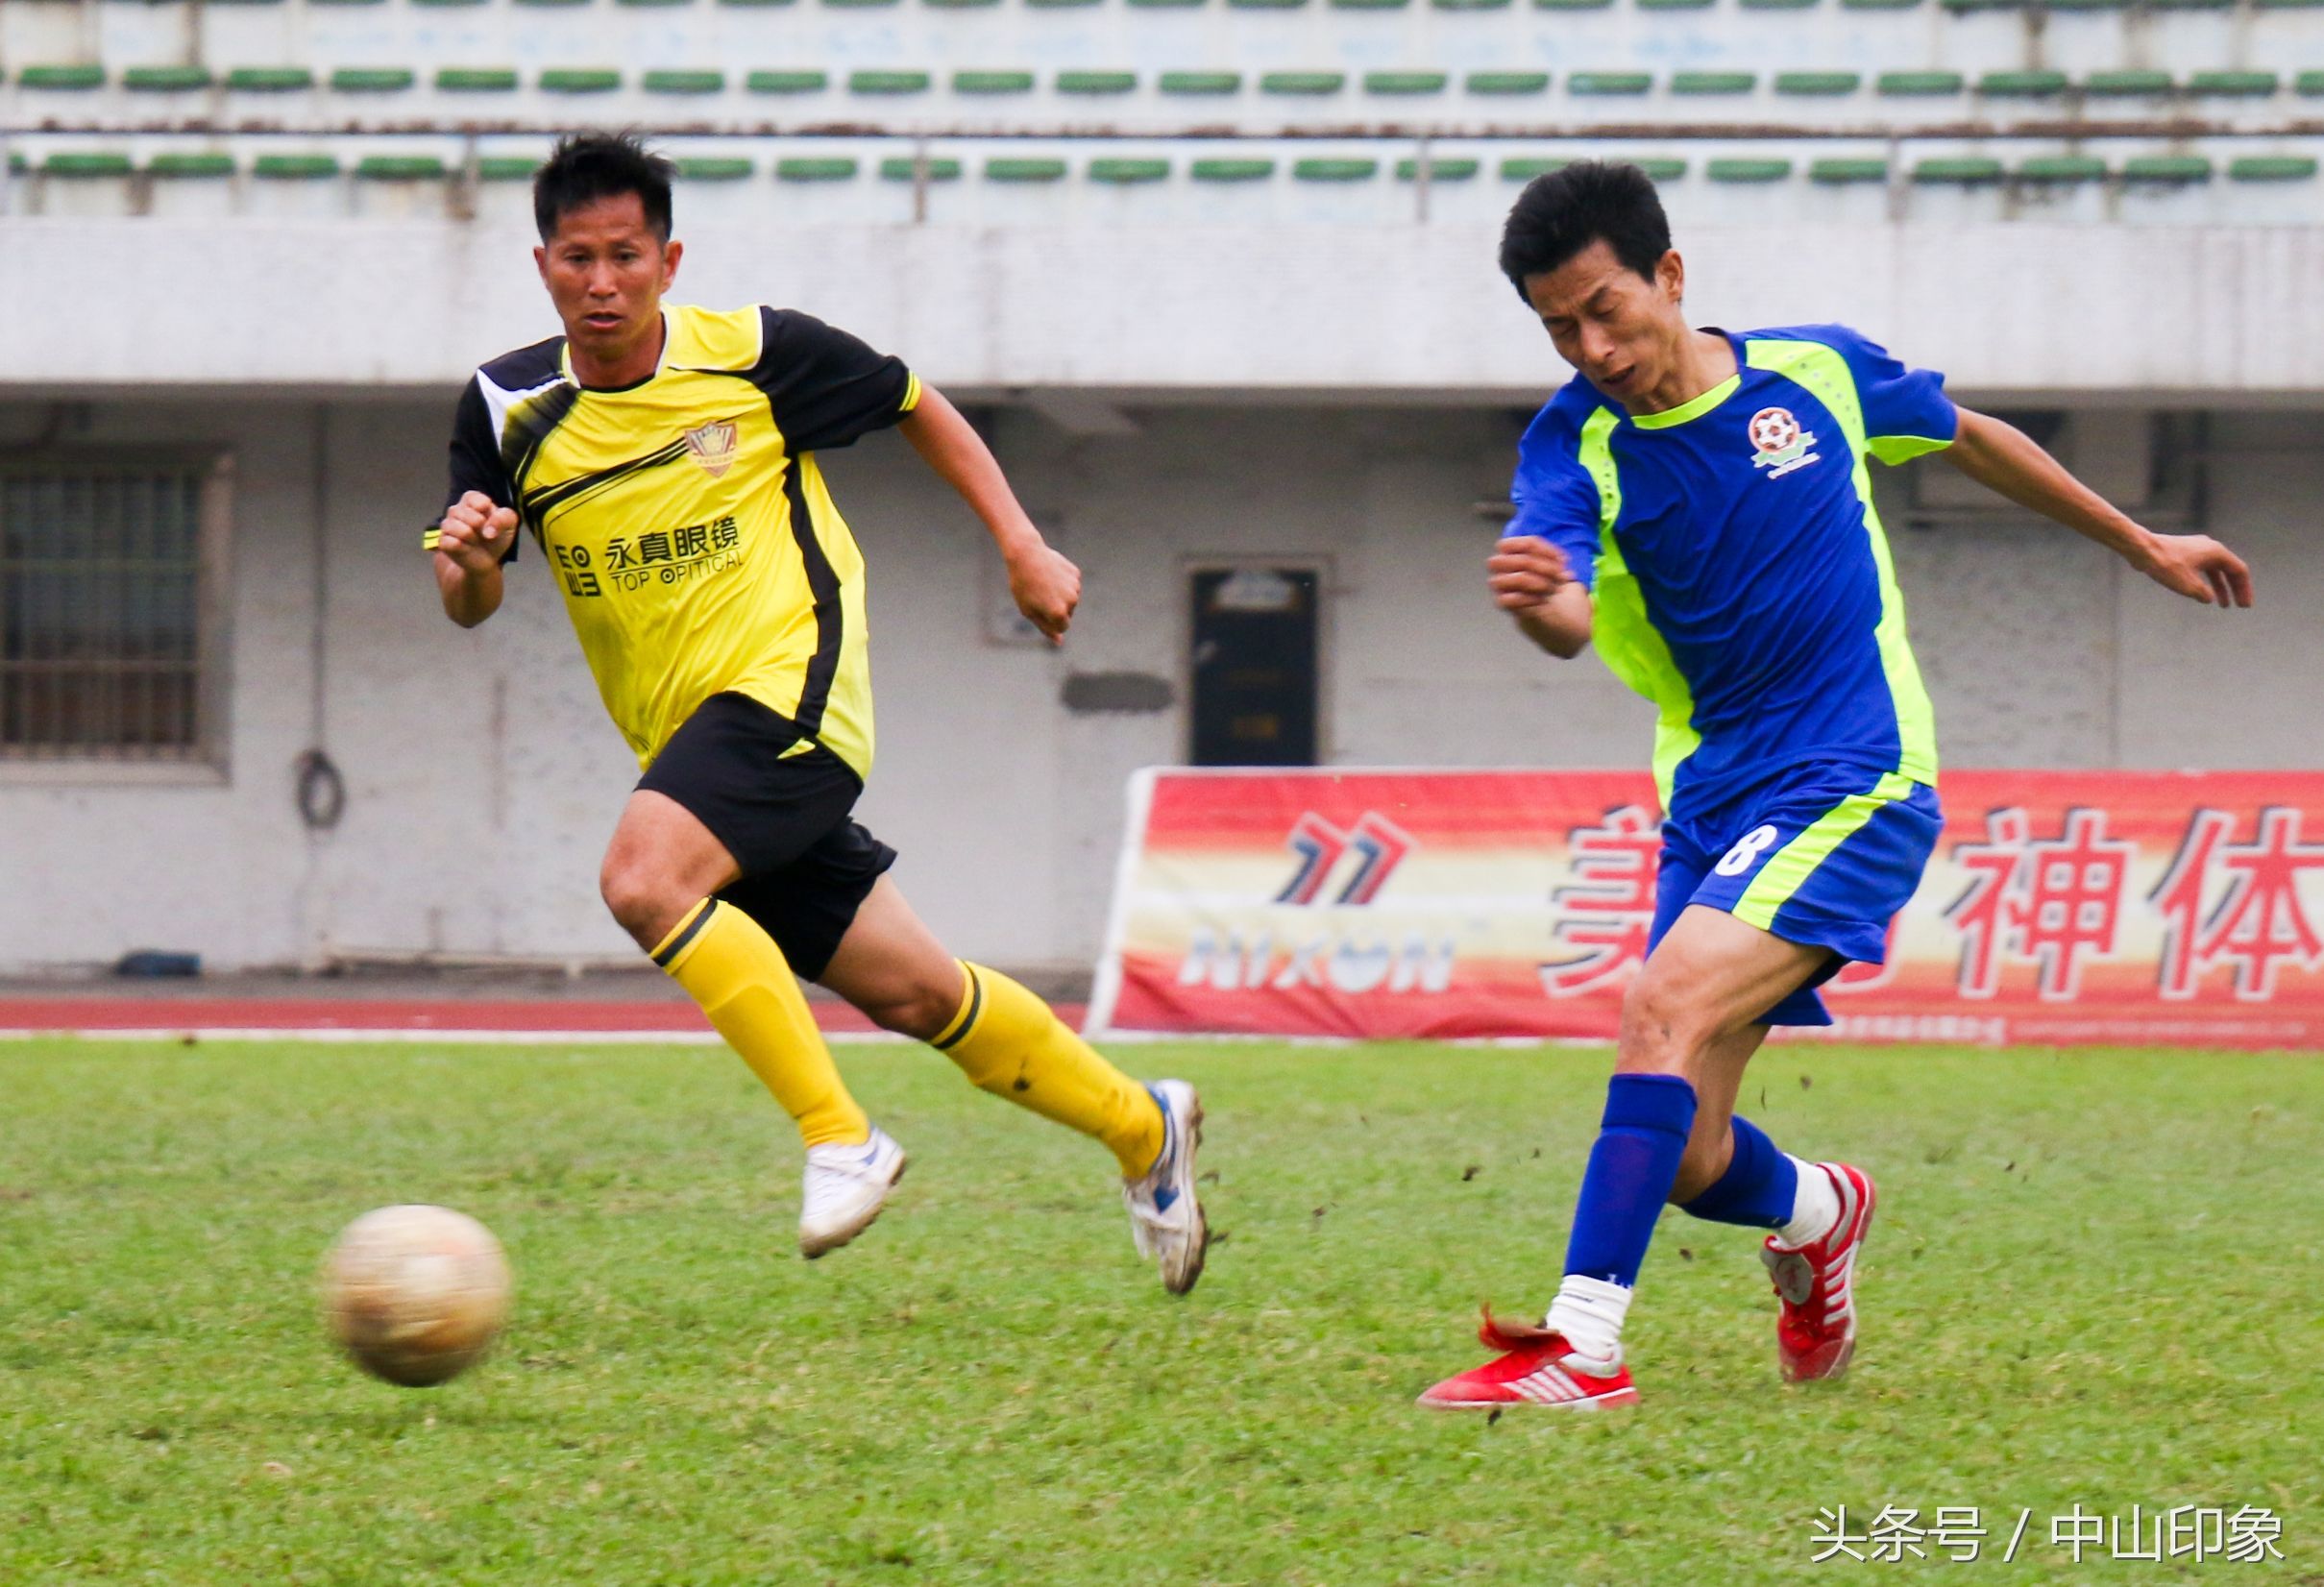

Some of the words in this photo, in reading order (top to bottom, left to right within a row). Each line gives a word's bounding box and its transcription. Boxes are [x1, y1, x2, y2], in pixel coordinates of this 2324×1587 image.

[605, 516, 740, 570] 永真眼镜
[611, 571, 650, 593] TOP
[661, 549, 745, 584] OPITICAL
[1714, 824, 1778, 877] 8
[1539, 805, 2324, 1002] 美神体
[1177, 925, 1456, 992] NIXON
